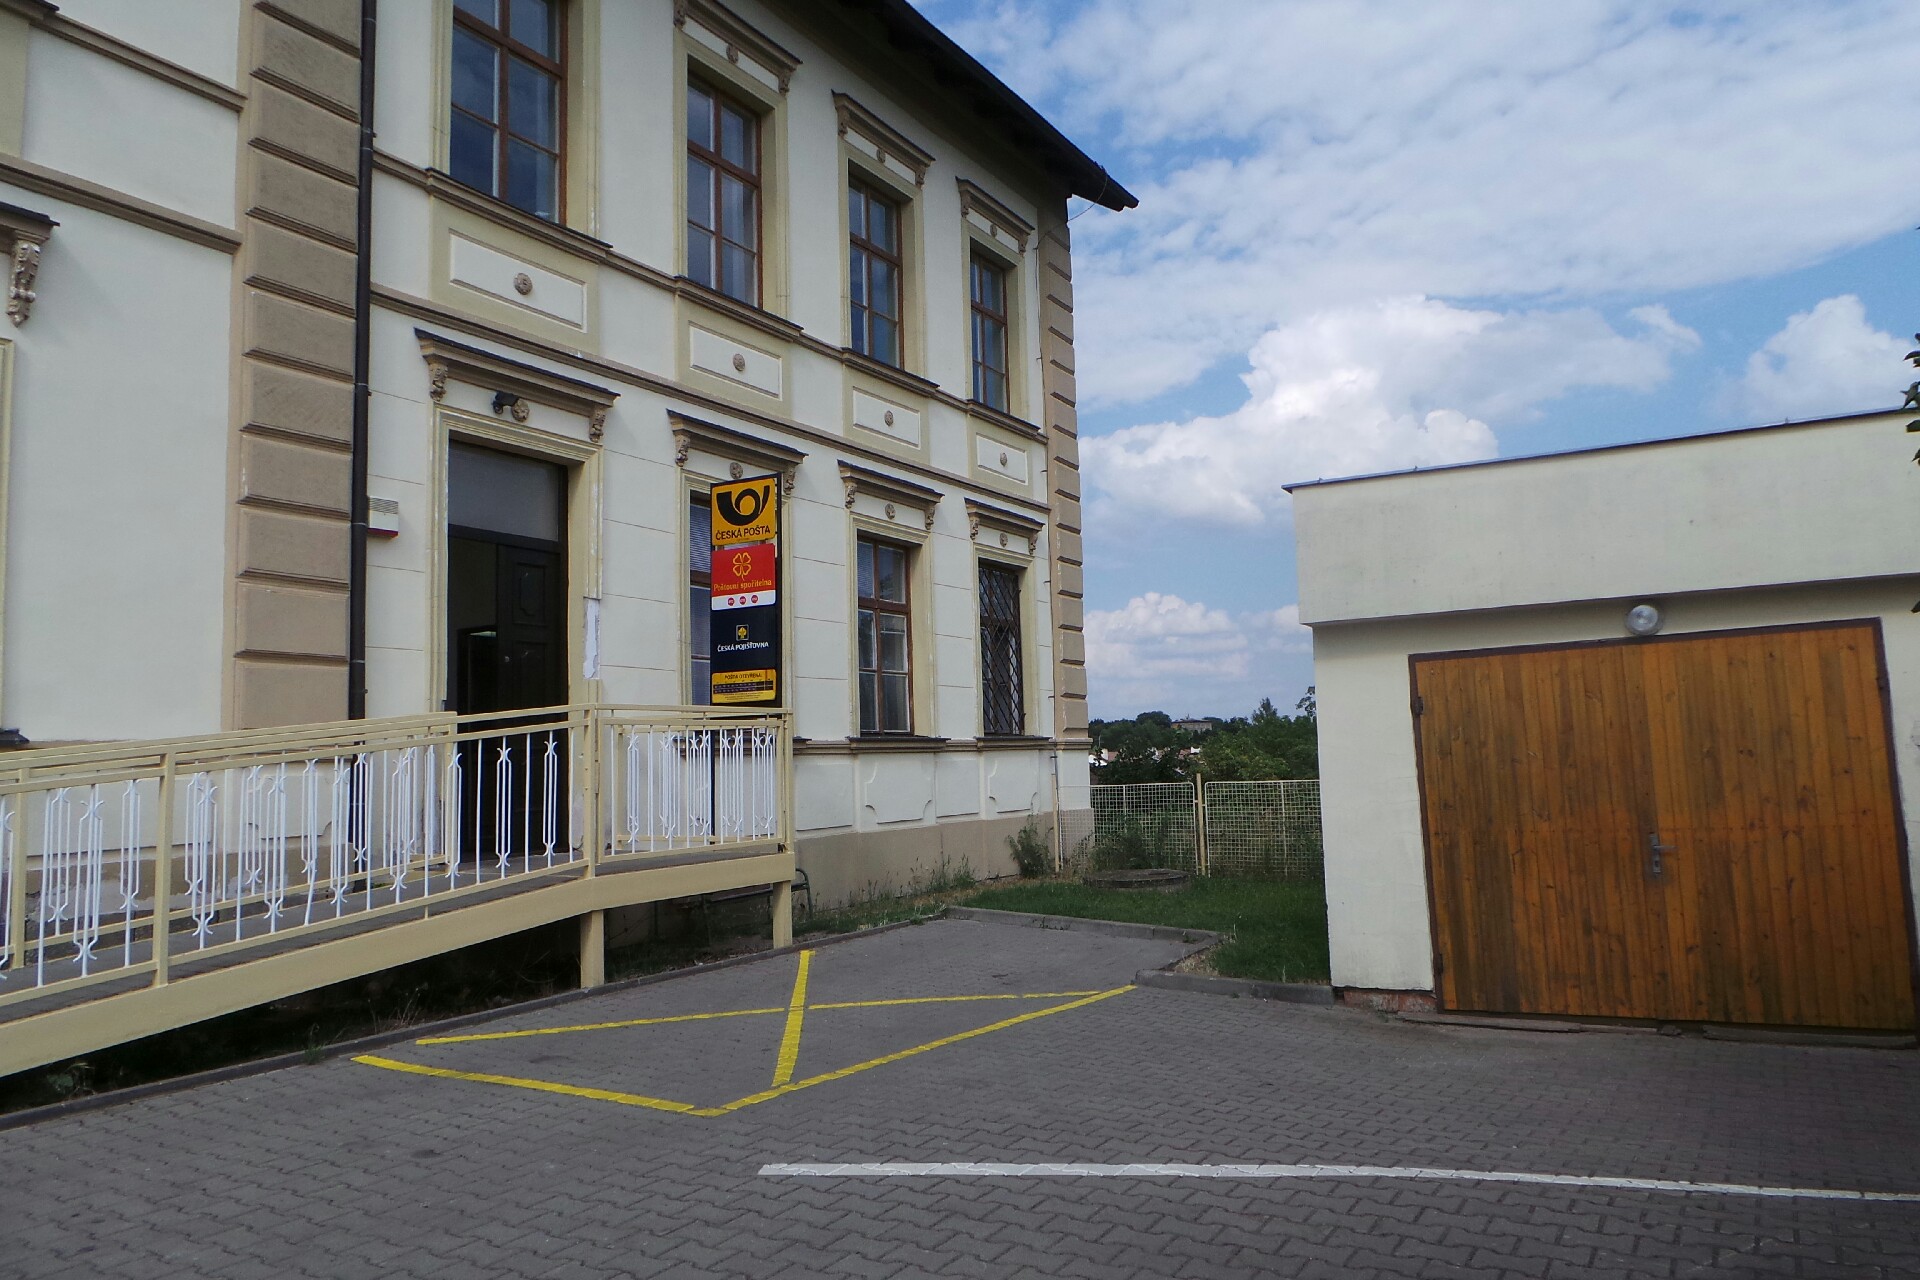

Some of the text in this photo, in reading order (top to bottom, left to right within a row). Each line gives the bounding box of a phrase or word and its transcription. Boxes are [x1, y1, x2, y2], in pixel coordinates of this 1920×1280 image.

[715, 525, 770, 540] ČESKÁ POŠTA
[714, 579, 771, 592] Poštovní spořitelna
[717, 641, 769, 652] ČESKÁ POJIŠŤOVNA
